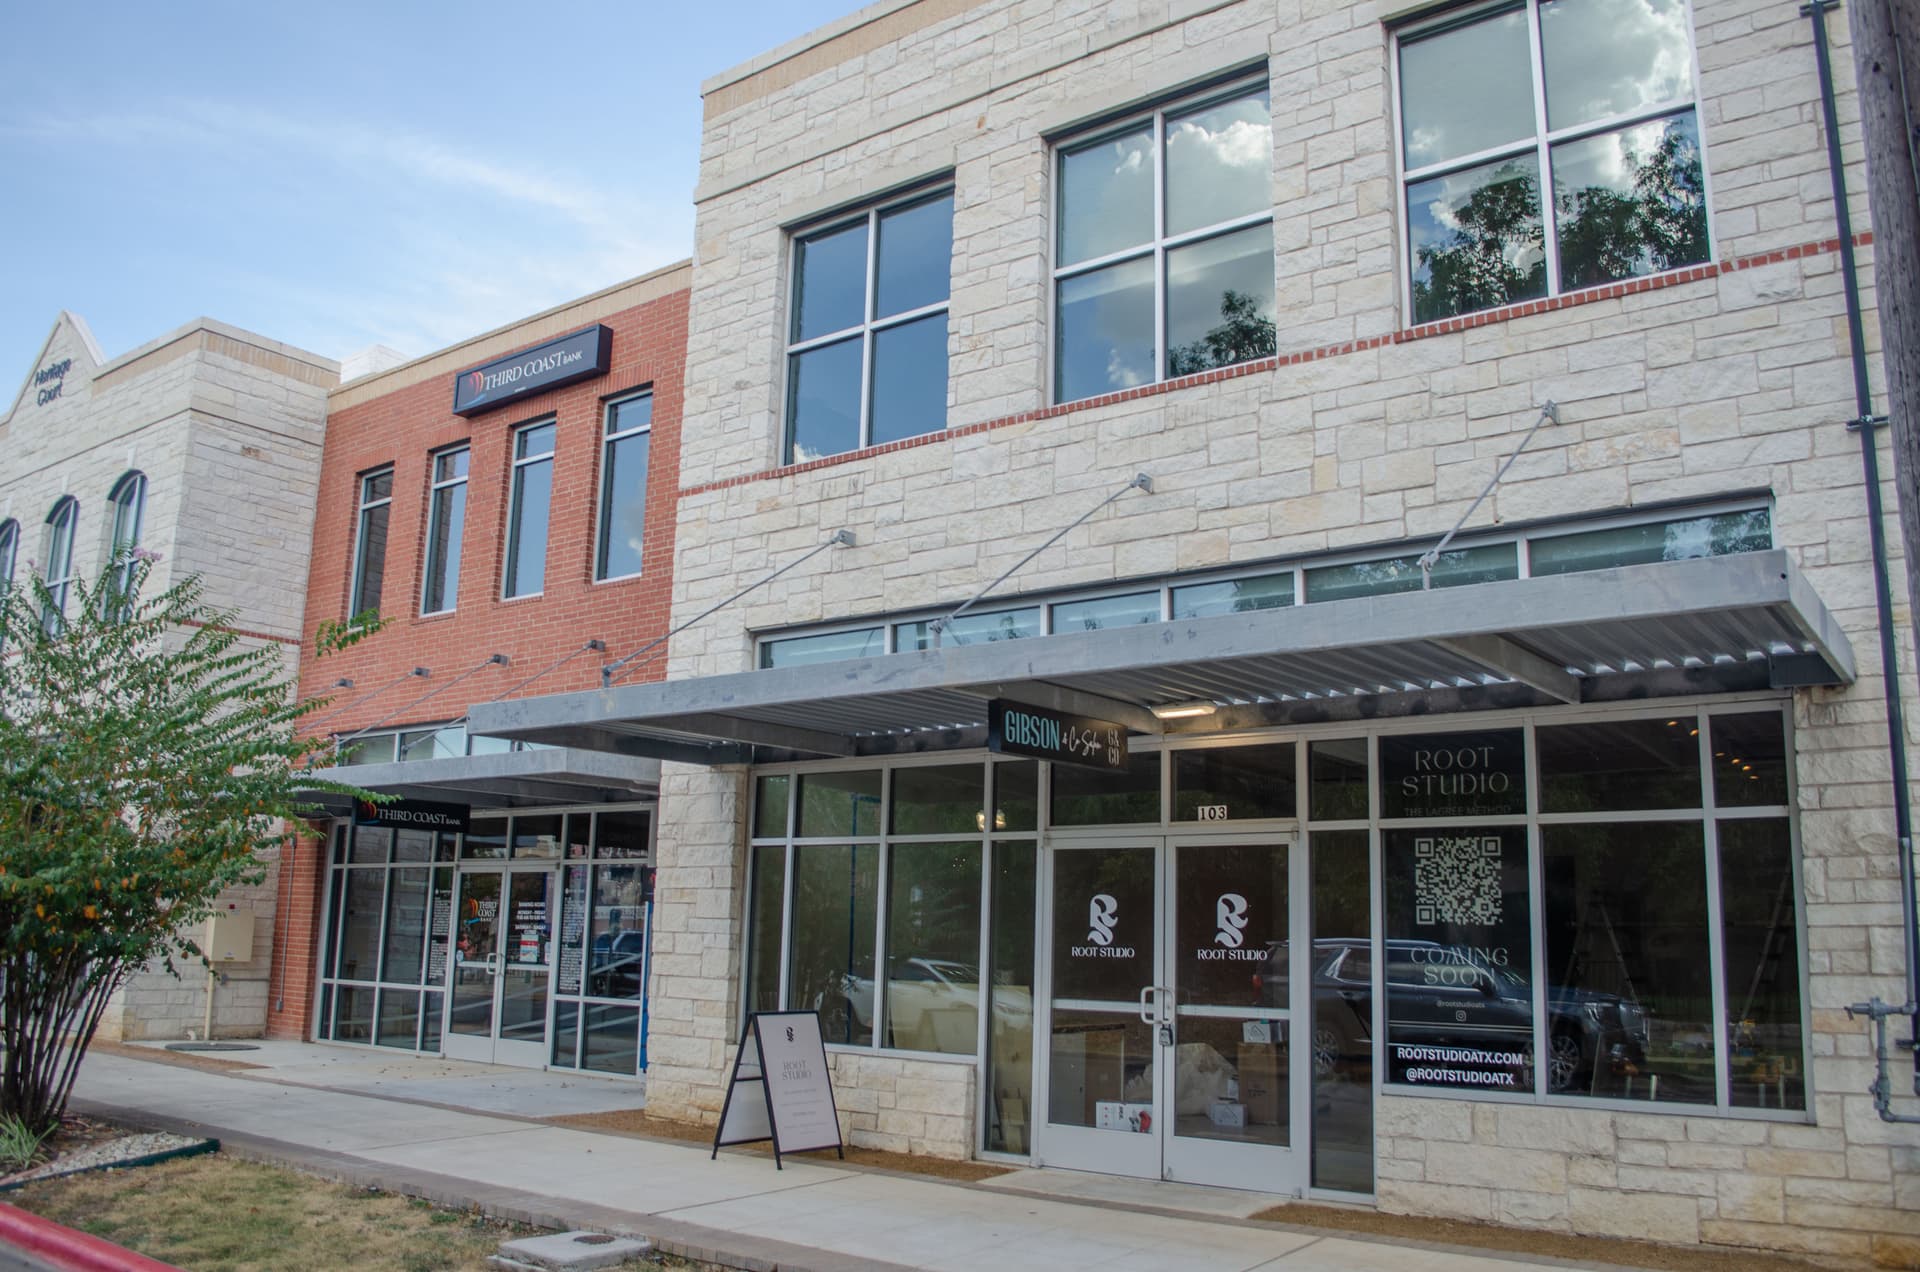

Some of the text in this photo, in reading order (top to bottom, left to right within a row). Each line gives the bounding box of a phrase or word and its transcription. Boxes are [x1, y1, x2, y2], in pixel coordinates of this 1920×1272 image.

[34, 358, 72, 388] Heritage
[484, 350, 583, 391] THIRD COAST BANK
[37, 381, 63, 407] Court
[1005, 710, 1060, 751] GIBSON
[1415, 746, 1495, 771] ROOT
[1402, 771, 1509, 797] STUDIO
[378, 808, 412, 821] THIRD
[413, 811, 447, 825] COAST
[1200, 806, 1226, 820] 103
[477, 909, 496, 917] COAST
[1071, 946, 1135, 958] ROOT STUDIO
[1197, 949, 1268, 961] ROOT STUDIO
[1410, 946, 1509, 967] COMING
[1423, 966, 1496, 986] SOON
[1397, 1047, 1524, 1065] ROOTSTUDIOATX.COM
[1406, 1068, 1515, 1085] @ROOTSTUDIOATX
